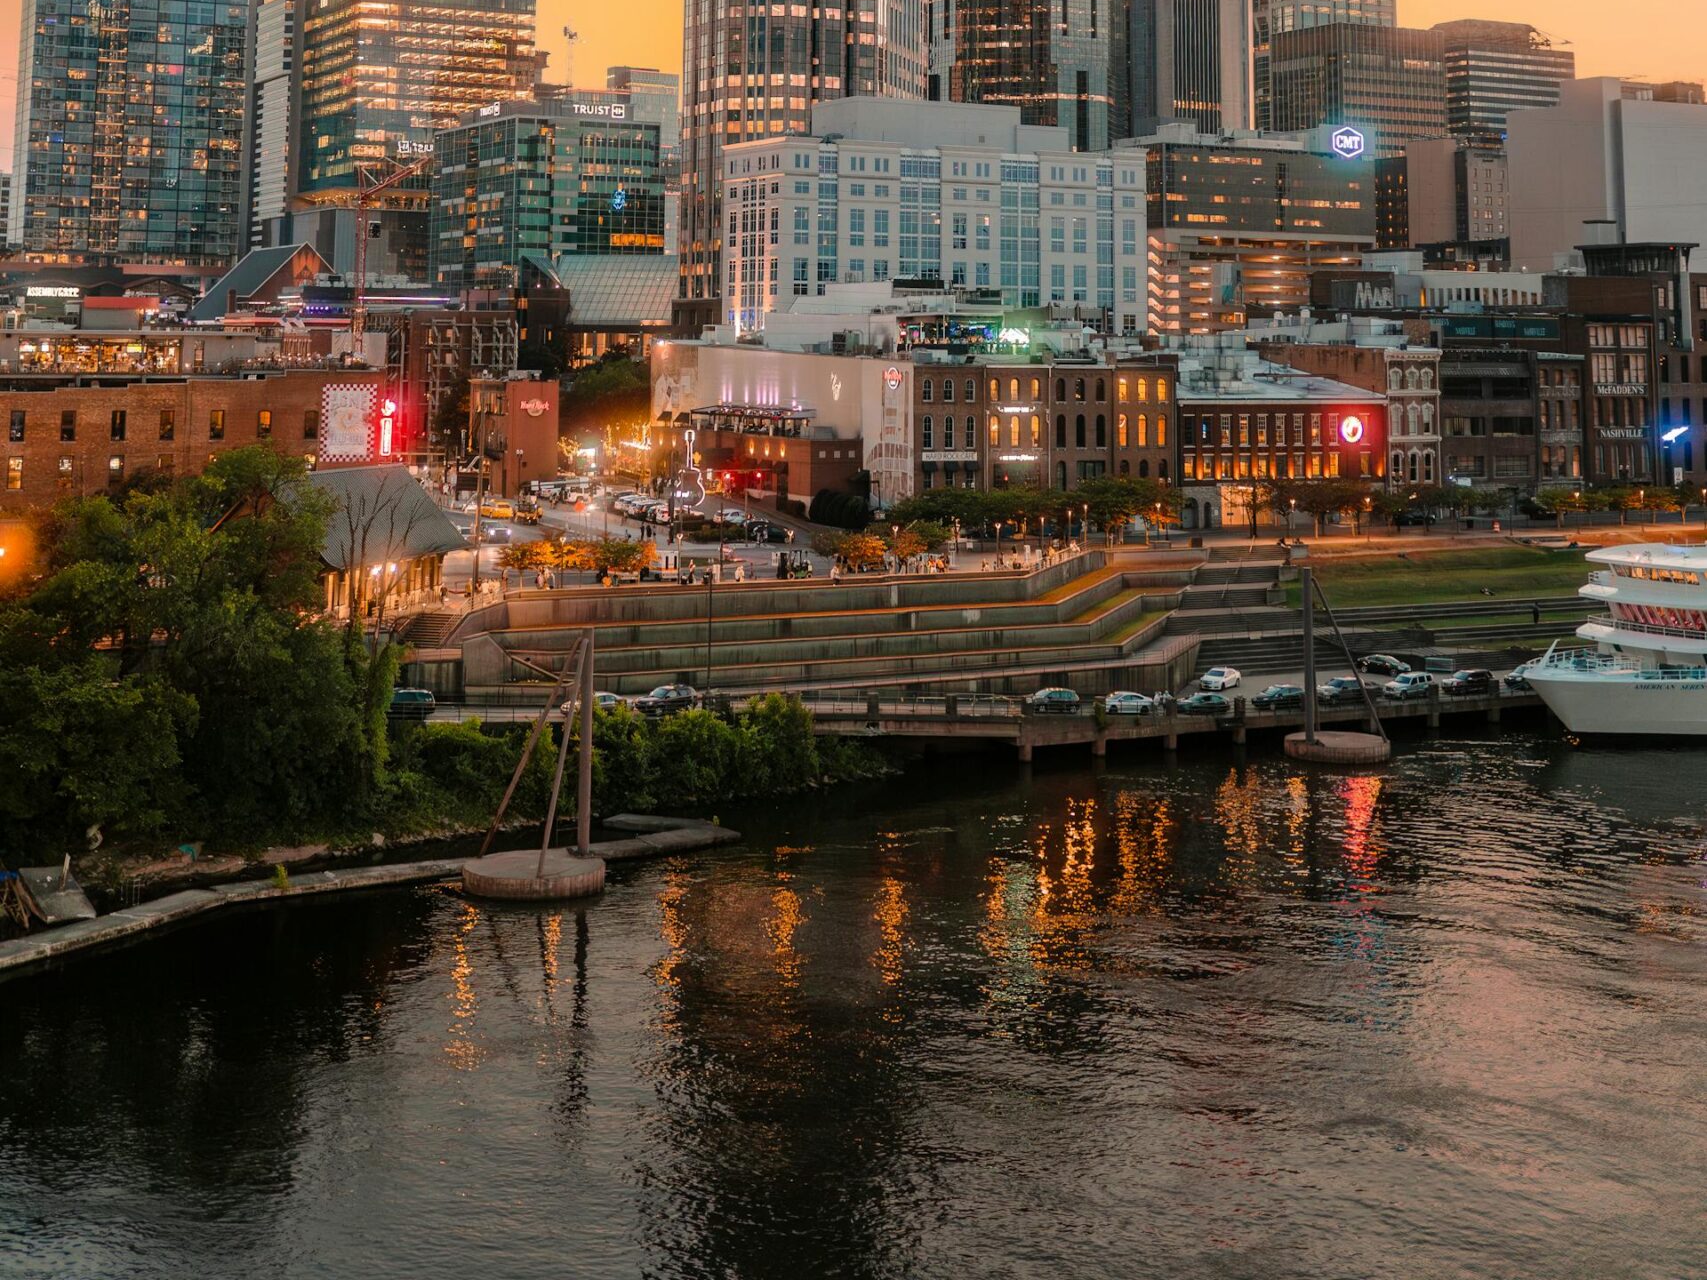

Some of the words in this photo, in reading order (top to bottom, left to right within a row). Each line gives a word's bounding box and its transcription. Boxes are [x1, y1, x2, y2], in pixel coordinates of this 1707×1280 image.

[573, 105, 610, 115] TRUIST
[1335, 136, 1361, 150] CMT
[1597, 385, 1645, 395] McFADDEN'S
[1600, 428, 1643, 438] NASHVILLE
